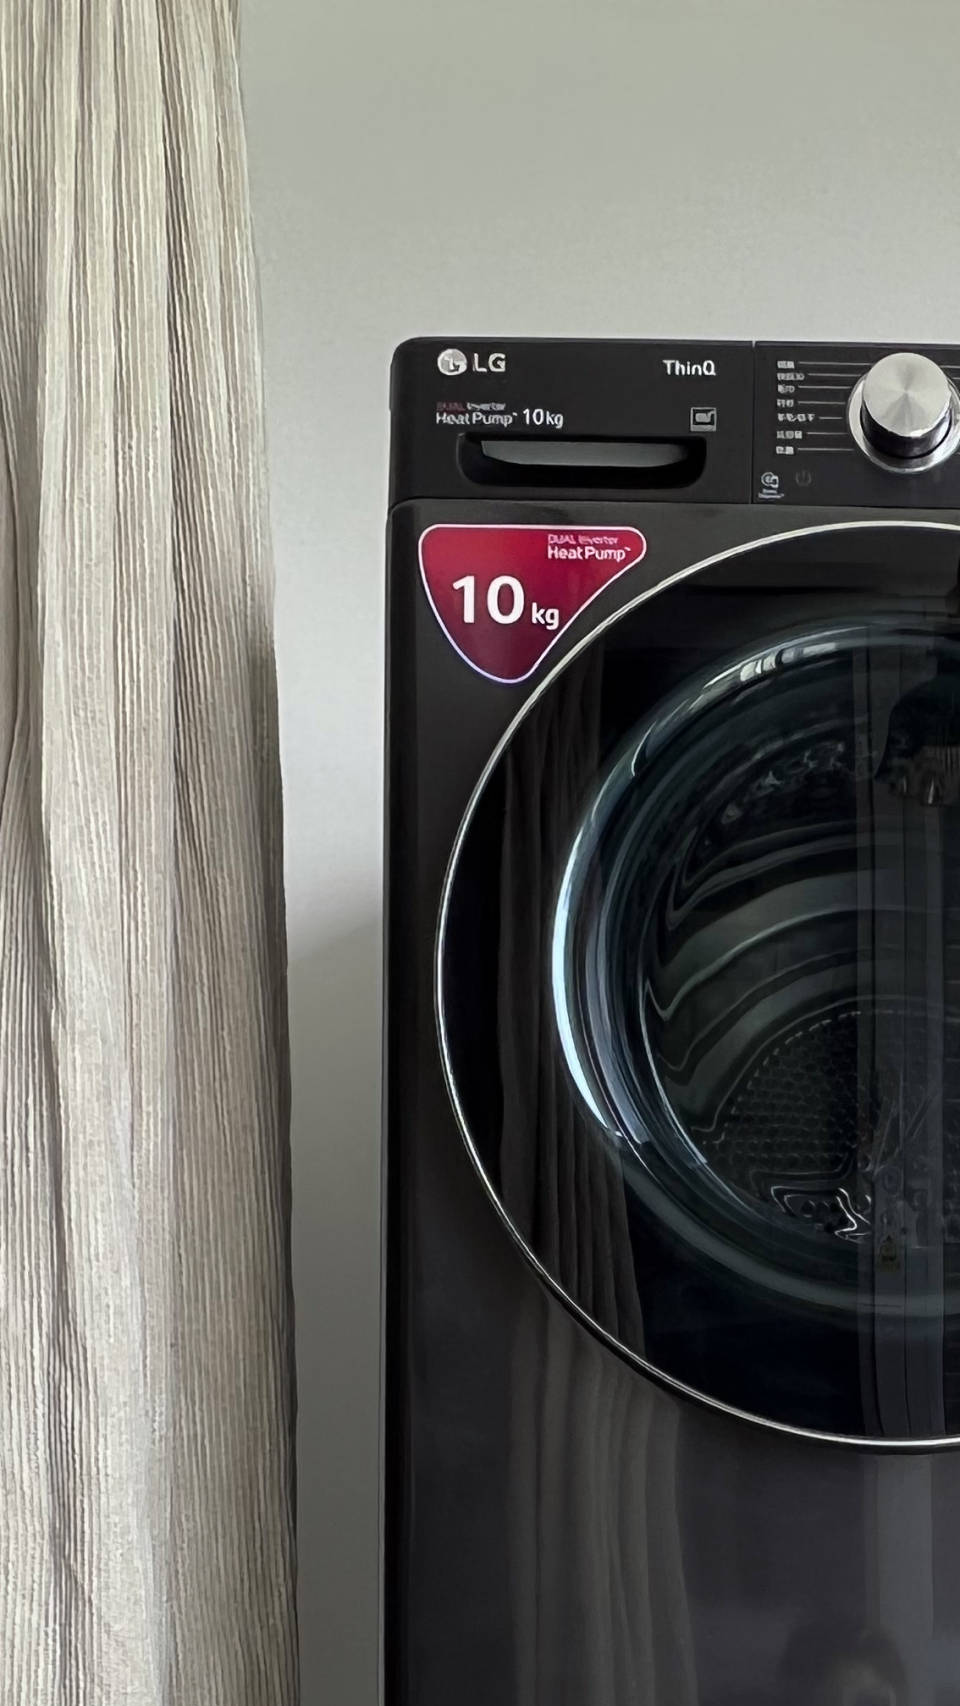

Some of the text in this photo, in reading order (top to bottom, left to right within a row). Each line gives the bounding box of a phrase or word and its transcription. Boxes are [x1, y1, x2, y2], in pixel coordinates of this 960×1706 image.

[472, 352, 506, 372] LG
[662, 359, 717, 376] ThinQ
[547, 546, 583, 560] Heat
